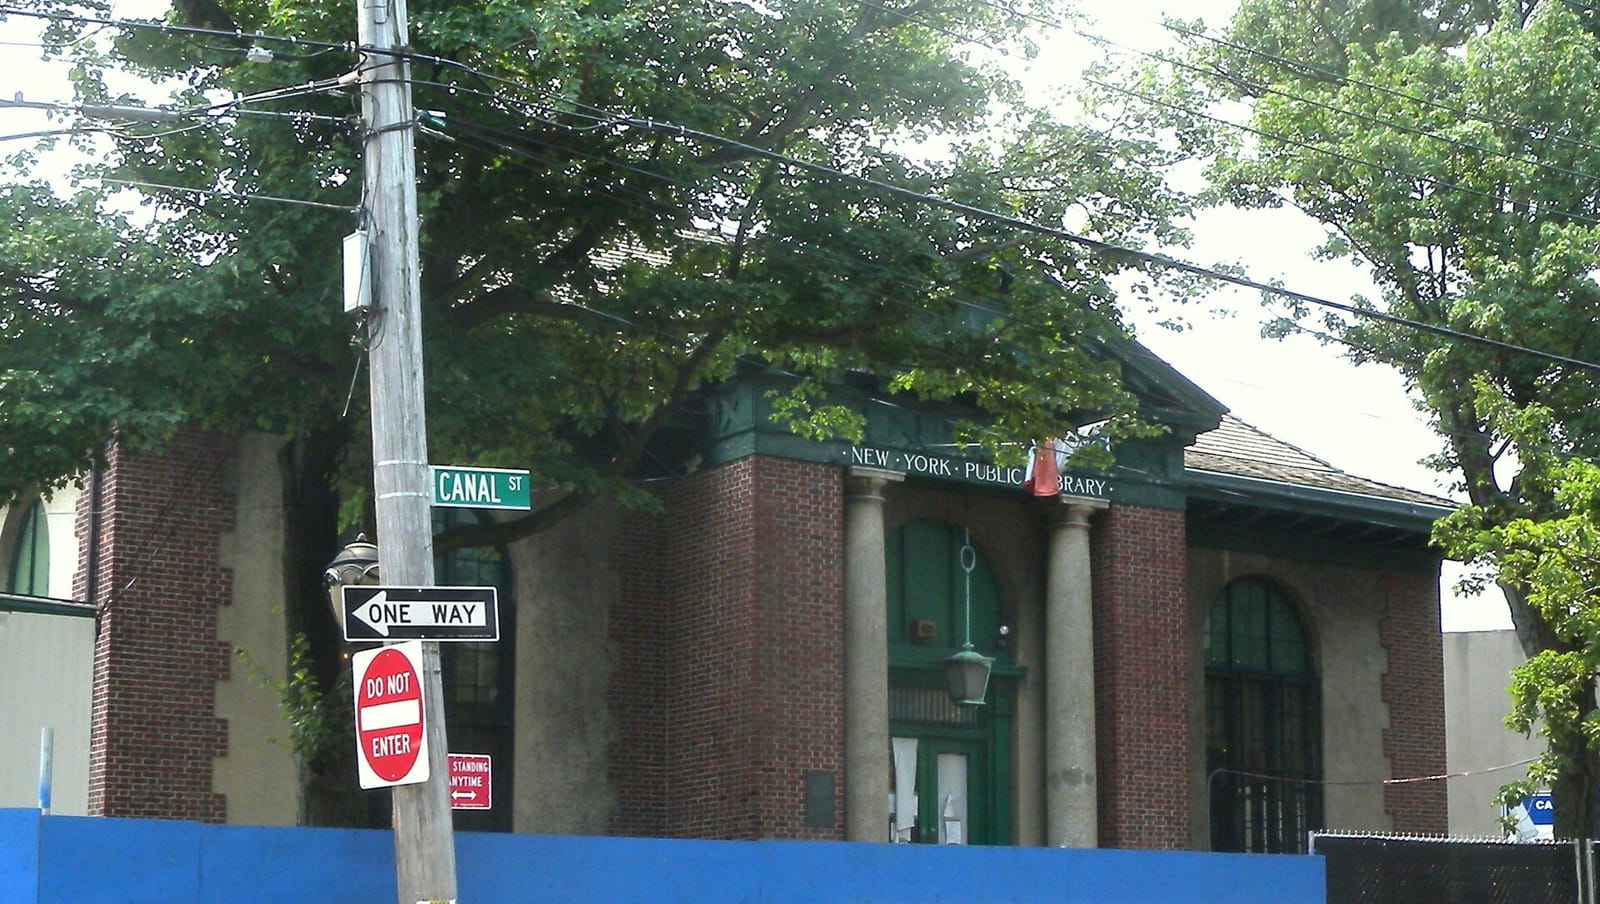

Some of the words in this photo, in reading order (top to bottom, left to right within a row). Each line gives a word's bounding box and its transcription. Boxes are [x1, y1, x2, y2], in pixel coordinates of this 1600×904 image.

[852, 446, 889, 466] NEW
[903, 453, 952, 476] YORK
[965, 462, 1022, 485] PUBLIC
[1057, 474, 1106, 496] BRARY
[440, 472, 501, 503] CANAL
[508, 476, 522, 491] ST
[369, 604, 411, 623] ONE
[432, 604, 475, 623] WAY
[367, 677, 384, 699] DO
[387, 672, 410, 696] NOT
[372, 733, 411, 758] ENTER
[453, 761, 488, 772] STANDING
